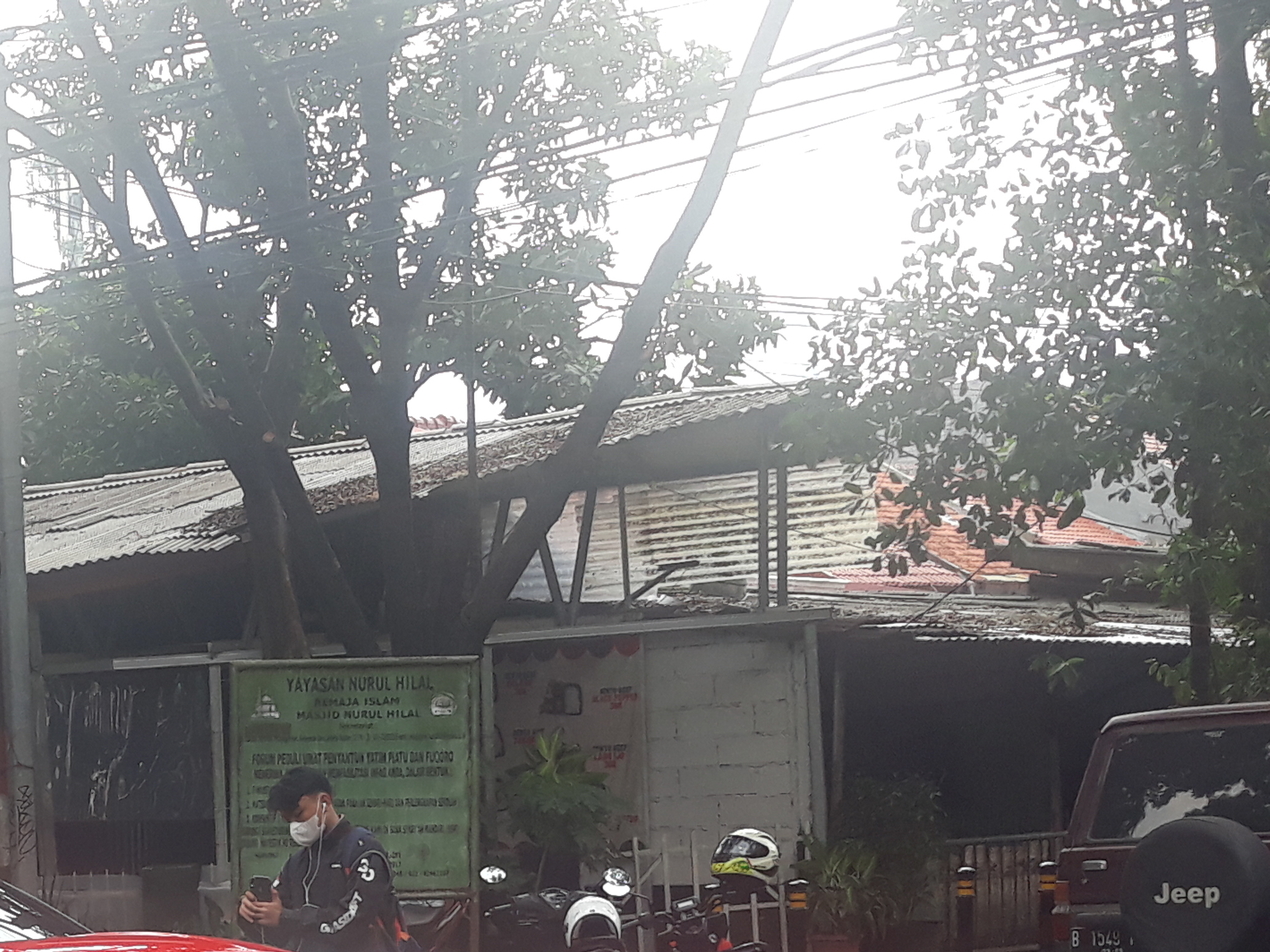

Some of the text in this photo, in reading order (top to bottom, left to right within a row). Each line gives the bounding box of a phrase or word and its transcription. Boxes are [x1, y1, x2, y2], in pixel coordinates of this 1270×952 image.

[286, 675, 435, 693] YAYASAN NURUL HILAL
[313, 696, 401, 708] REMAJA ISLAM
[296, 709, 421, 721] MASJID NURUL HILAL
[1154, 882, 1221, 909] Jeep
[1071, 930, 1080, 948] B
